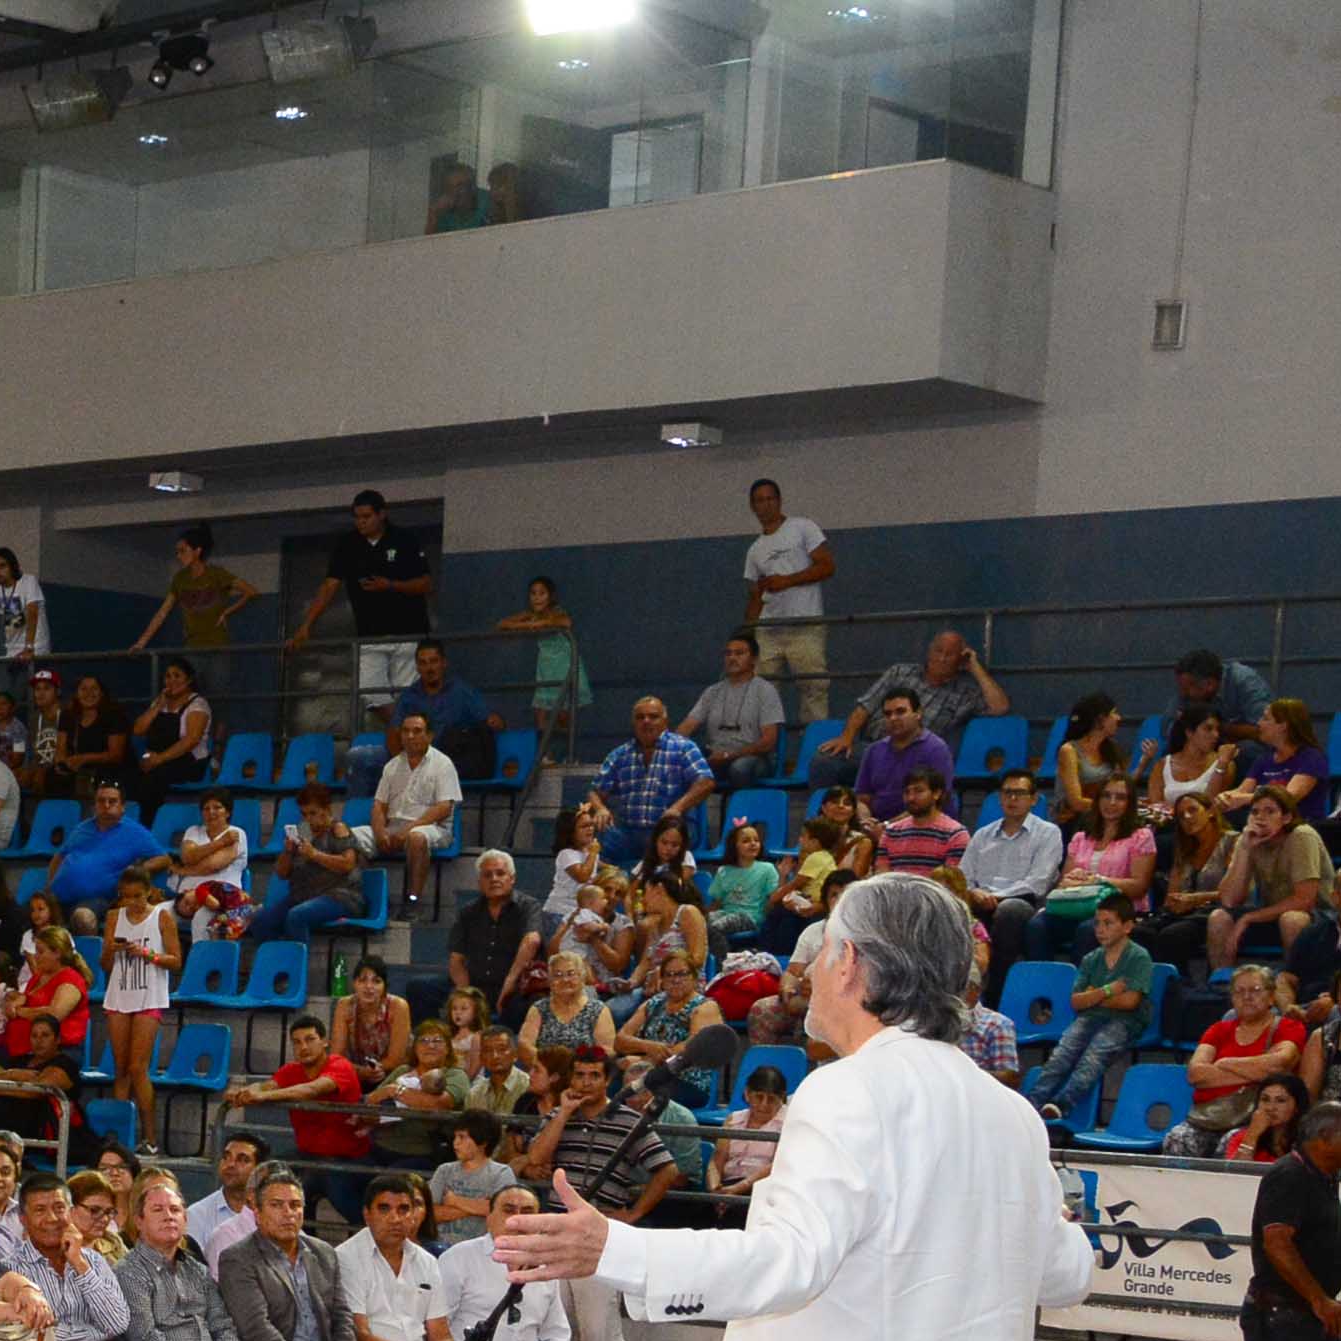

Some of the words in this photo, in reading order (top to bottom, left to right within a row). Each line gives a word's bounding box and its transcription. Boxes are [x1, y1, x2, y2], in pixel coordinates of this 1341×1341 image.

[1124, 1262, 1155, 1278] Villa
[1160, 1265, 1232, 1285] Mercedes
[1124, 1279, 1174, 1296] Grande
